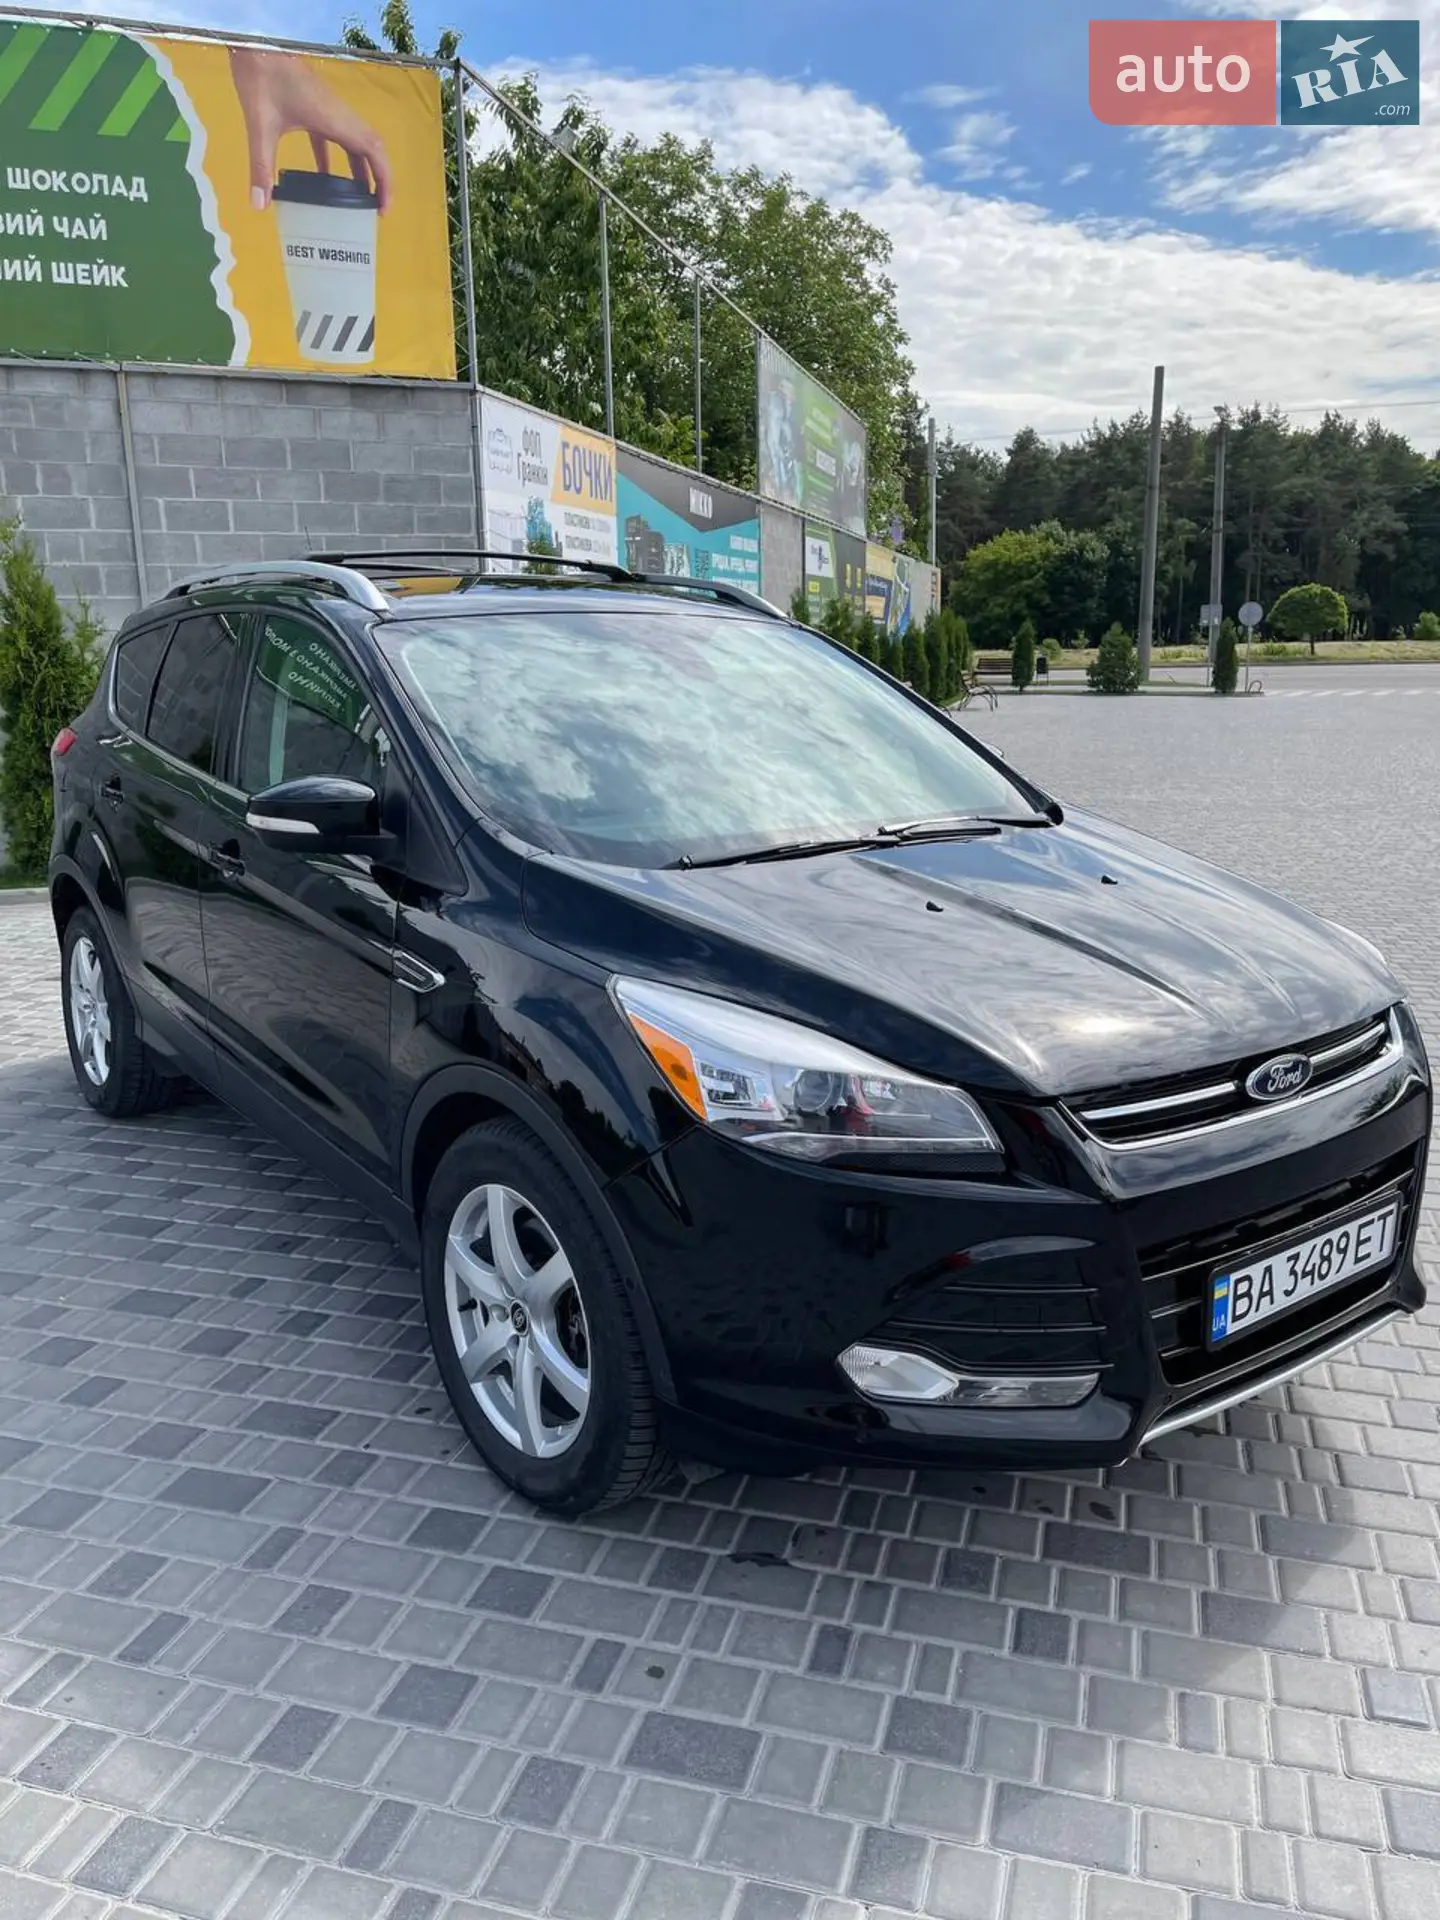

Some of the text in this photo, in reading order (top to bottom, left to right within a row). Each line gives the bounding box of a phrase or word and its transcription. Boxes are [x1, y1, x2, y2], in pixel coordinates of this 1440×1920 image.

[7, 166, 149, 203] ШОКОЛАД
[52, 212, 108, 241] ЧАЙ
[286, 244, 315, 259] BEST
[0, 253, 129, 288] ИЙ ШЕЙК
[561, 440, 613, 503] БОЧКИ
[1266, 1060, 1302, 1092] Ford
[1212, 1313, 1228, 1331] UA
